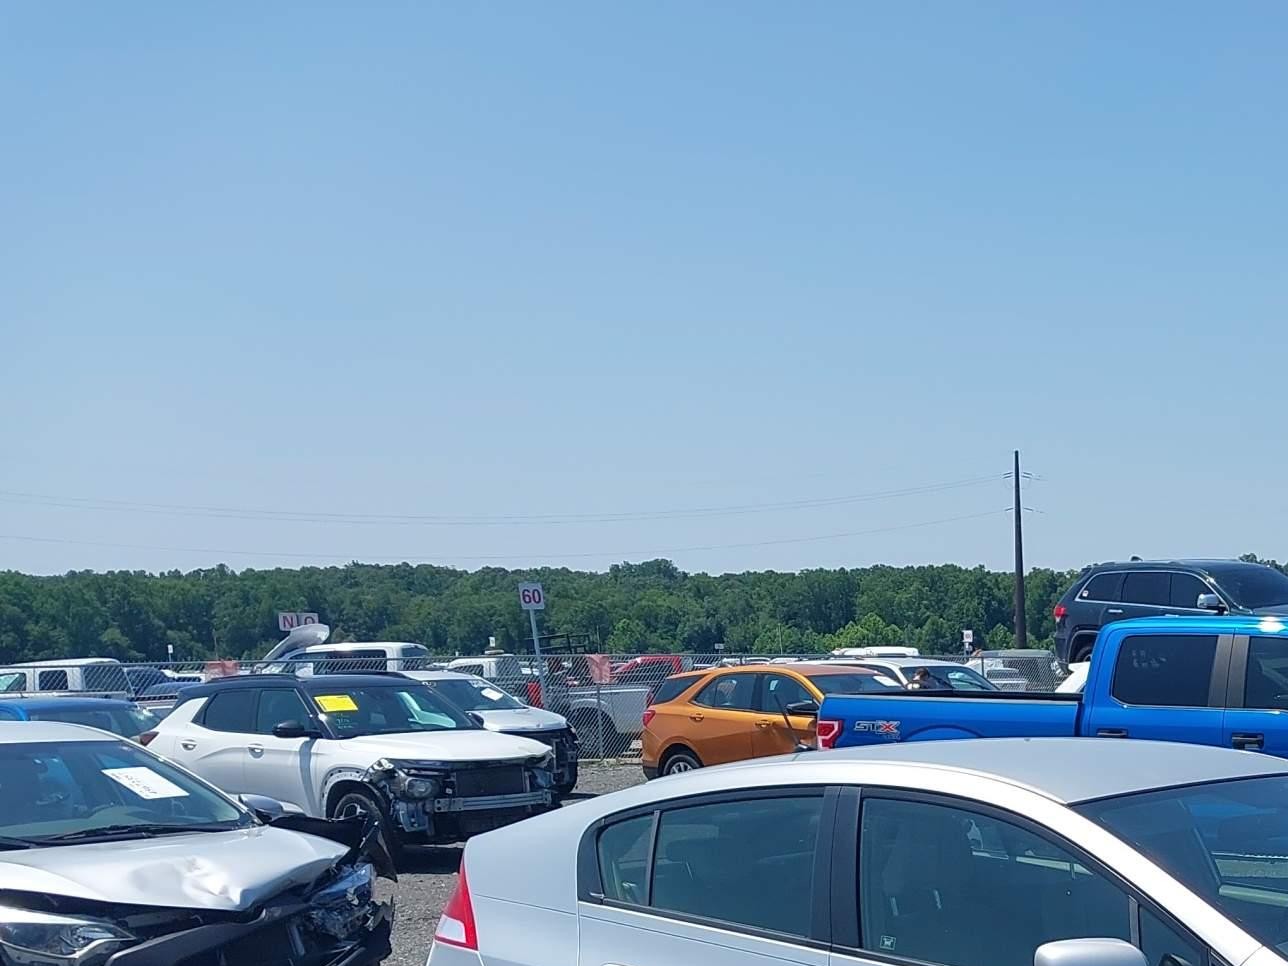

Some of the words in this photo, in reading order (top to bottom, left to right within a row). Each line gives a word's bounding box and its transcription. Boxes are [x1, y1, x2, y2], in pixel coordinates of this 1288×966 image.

[522, 588, 542, 604] 60
[282, 615, 294, 628] N
[854, 720, 901, 734] STX
